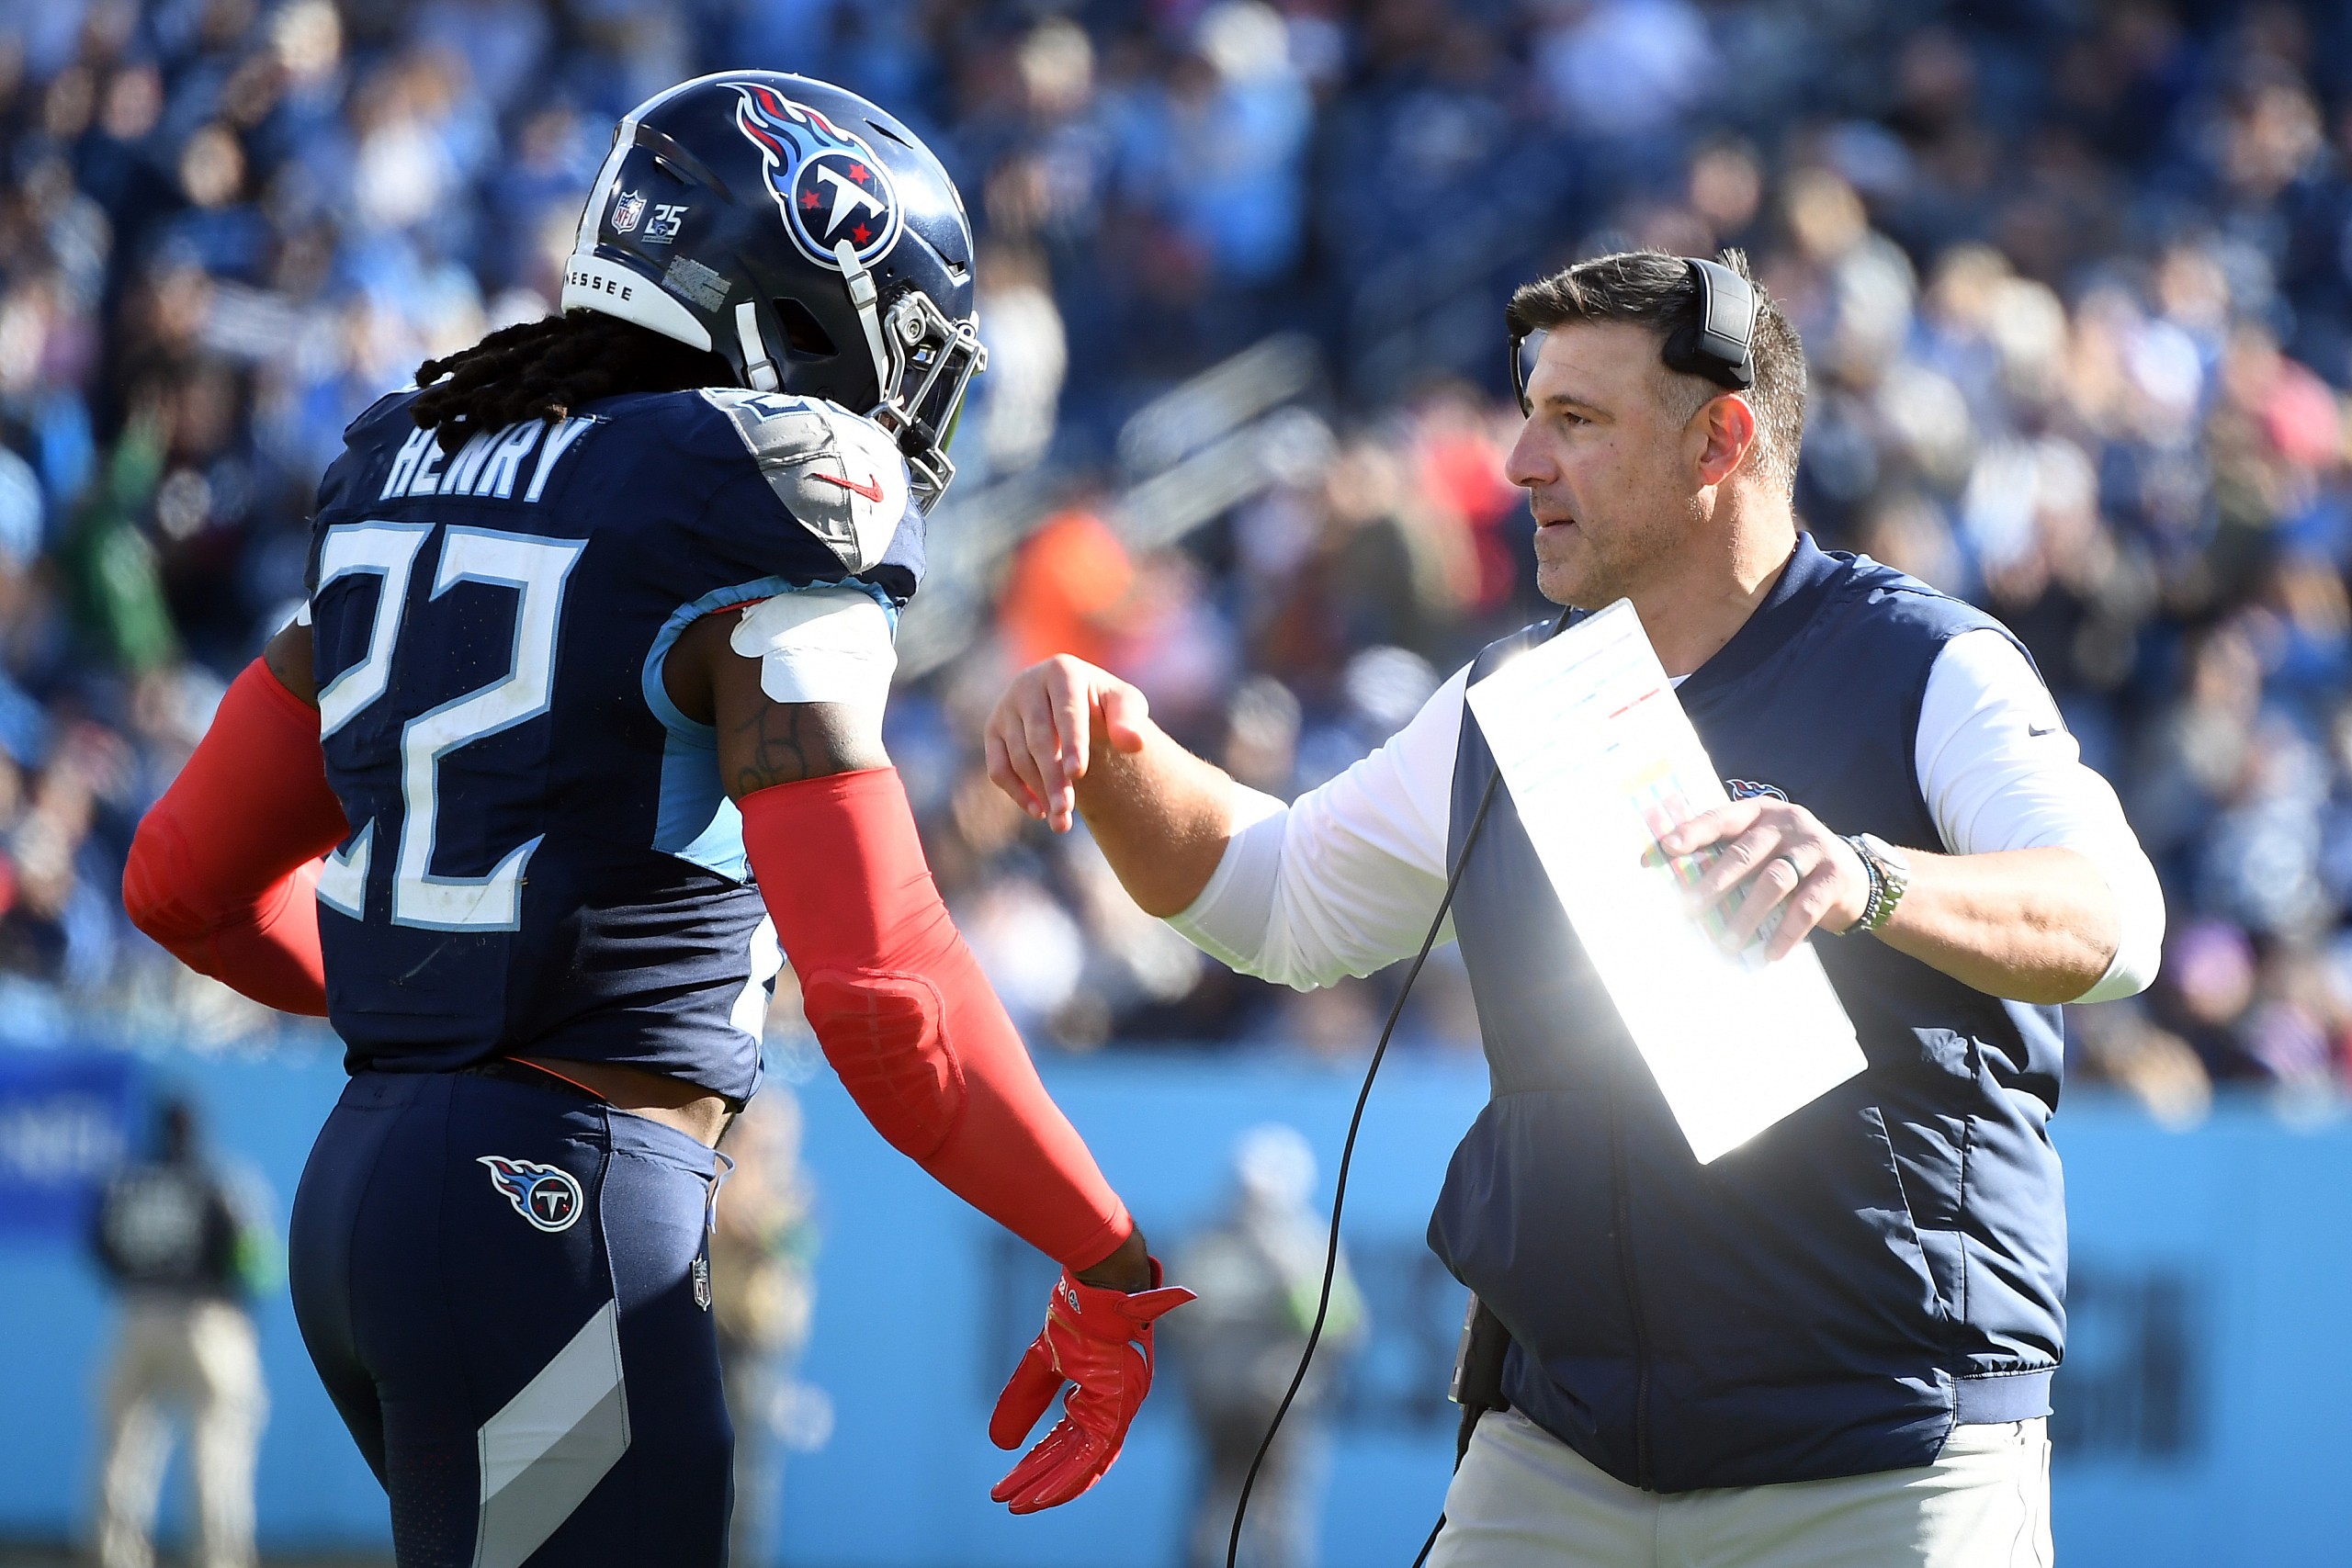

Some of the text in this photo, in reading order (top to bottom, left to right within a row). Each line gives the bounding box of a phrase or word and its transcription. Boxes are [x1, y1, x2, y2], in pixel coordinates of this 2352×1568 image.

[616, 207, 634, 228] NFL
[644, 204, 690, 236] 25
[379, 416, 596, 503] HENRY
[315, 520, 589, 932] 22
